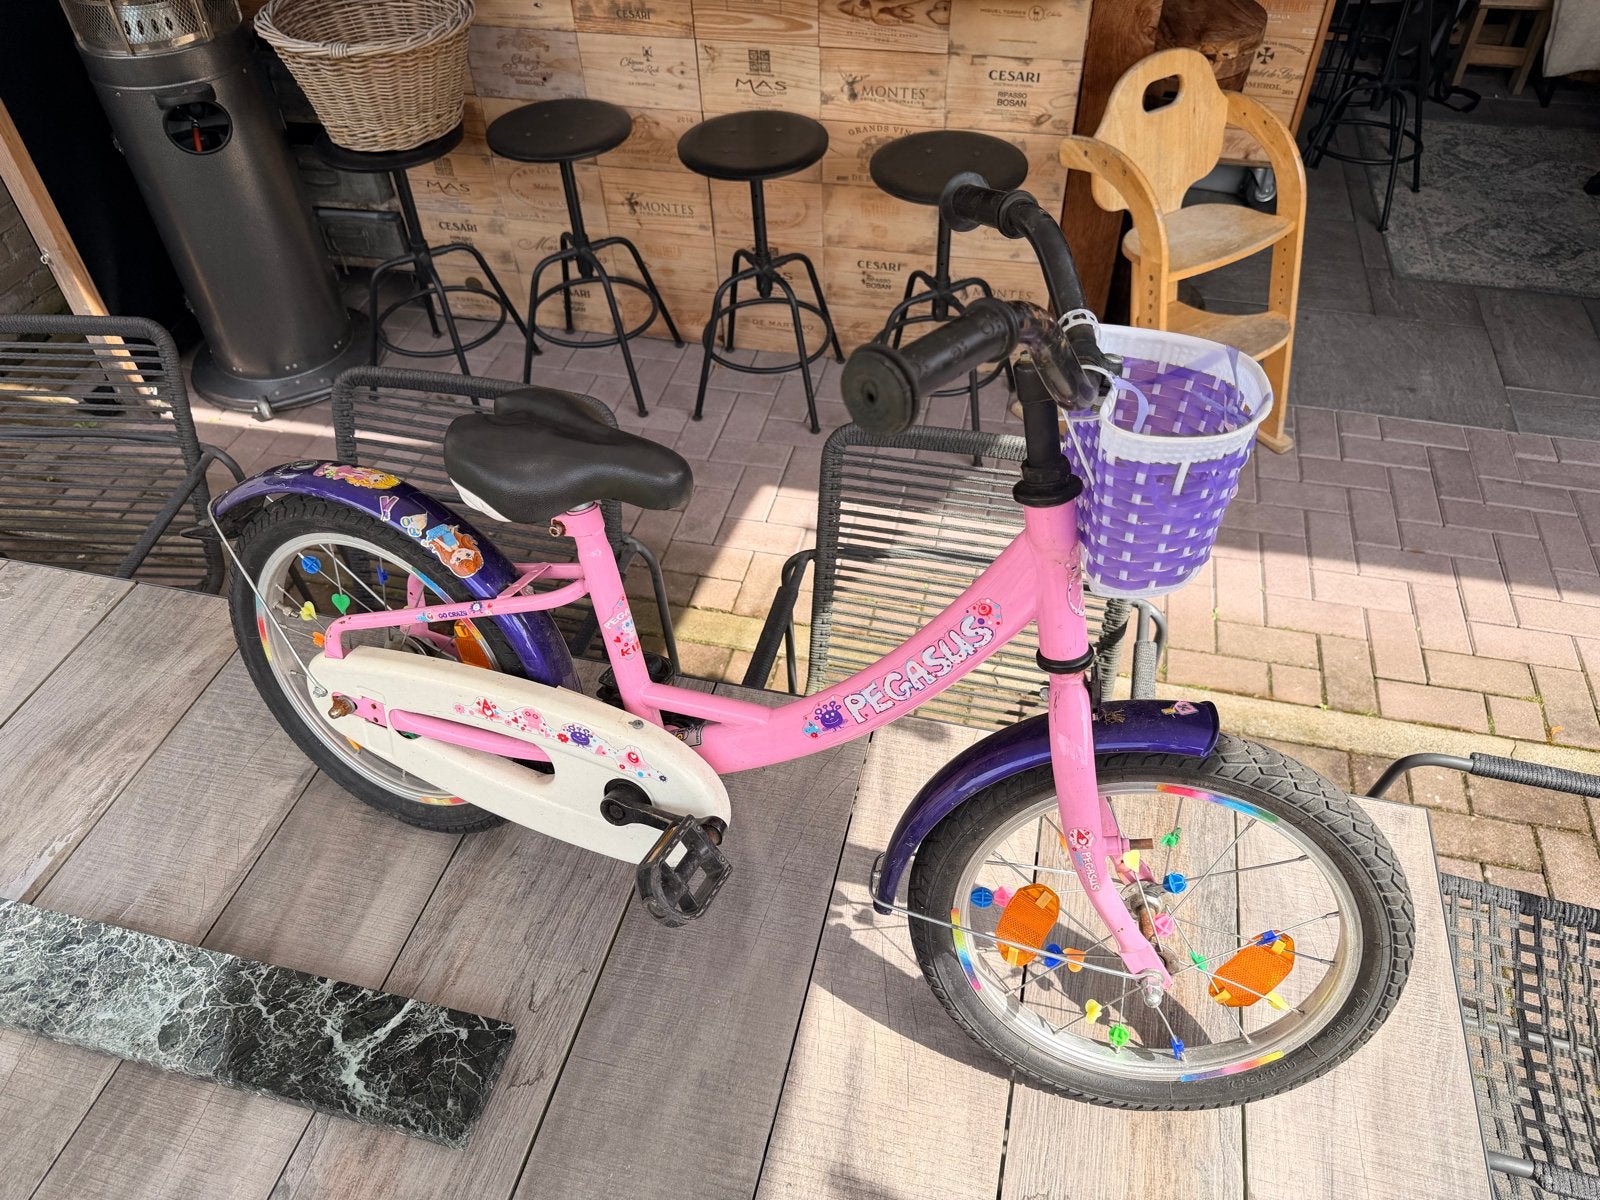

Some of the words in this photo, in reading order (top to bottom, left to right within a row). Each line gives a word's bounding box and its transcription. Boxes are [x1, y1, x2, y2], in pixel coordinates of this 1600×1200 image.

[616, 9, 651, 20] CESARI
[988, 69, 1041, 83] CESARI
[735, 78, 788, 97] MAS
[861, 85, 926, 100] MONTES
[997, 91, 1028, 99] RIPASSO
[996, 98, 1027, 107] BOSAN
[848, 124, 890, 137] GRANDS
[639, 201, 695, 216] MONTES
[438, 220, 478, 233] CESARI
[857, 260, 902, 272] CESARI
[843, 615, 994, 724] PEGASUS
[1081, 851, 1100, 892] PEGASUS
